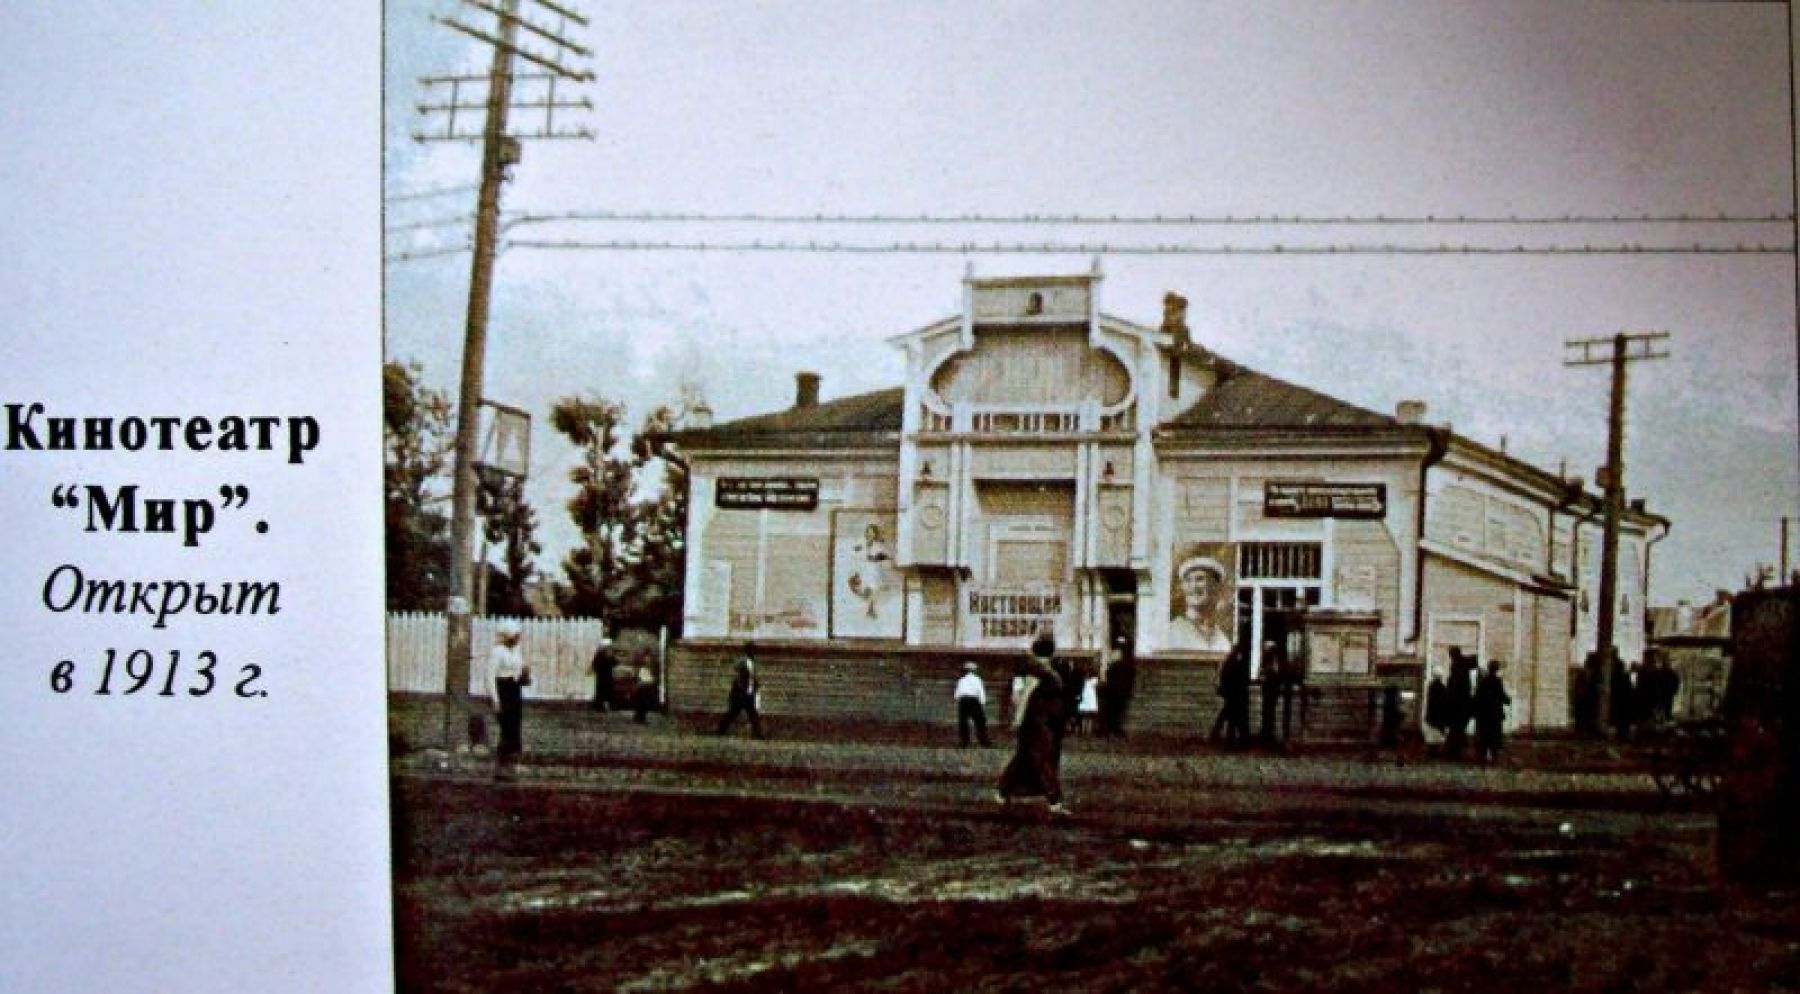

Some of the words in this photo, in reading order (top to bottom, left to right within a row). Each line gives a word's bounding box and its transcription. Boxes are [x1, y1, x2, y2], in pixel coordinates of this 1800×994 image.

[4, 403, 319, 463] Кинотеатр
[43, 565, 281, 628] Открыт
[51, 661, 75, 693] в
[95, 648, 216, 697] 1913
[236, 664, 267, 697] г.
